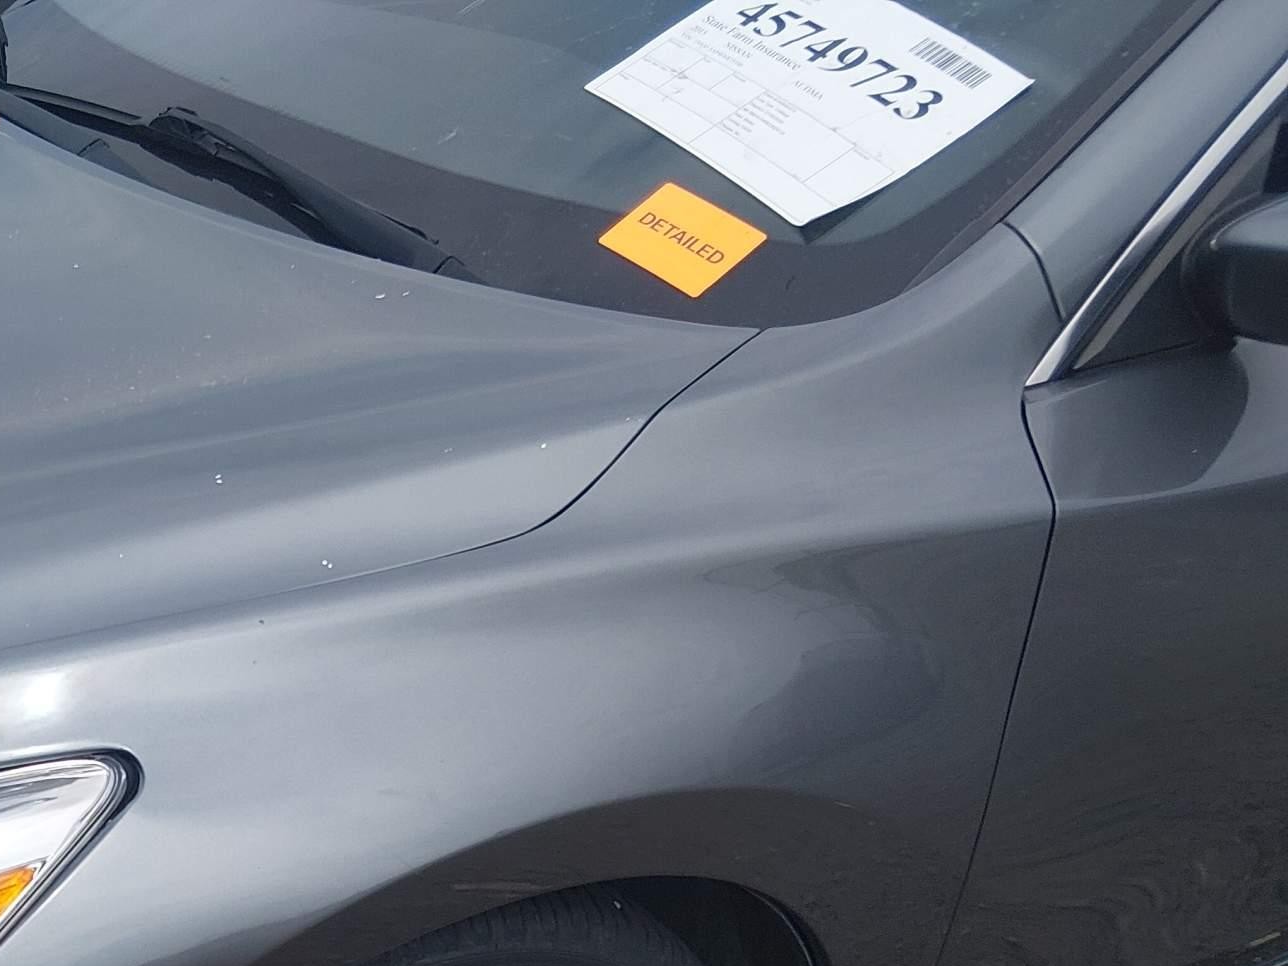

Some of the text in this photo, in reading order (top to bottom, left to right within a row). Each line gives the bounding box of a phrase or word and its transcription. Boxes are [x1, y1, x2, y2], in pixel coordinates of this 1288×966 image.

[703, 15, 729, 32] State
[727, 26, 754, 48] Farm
[754, 40, 801, 71] Insurance
[736, 2, 944, 121] 45749723
[637, 211, 727, 266] DETAILED
